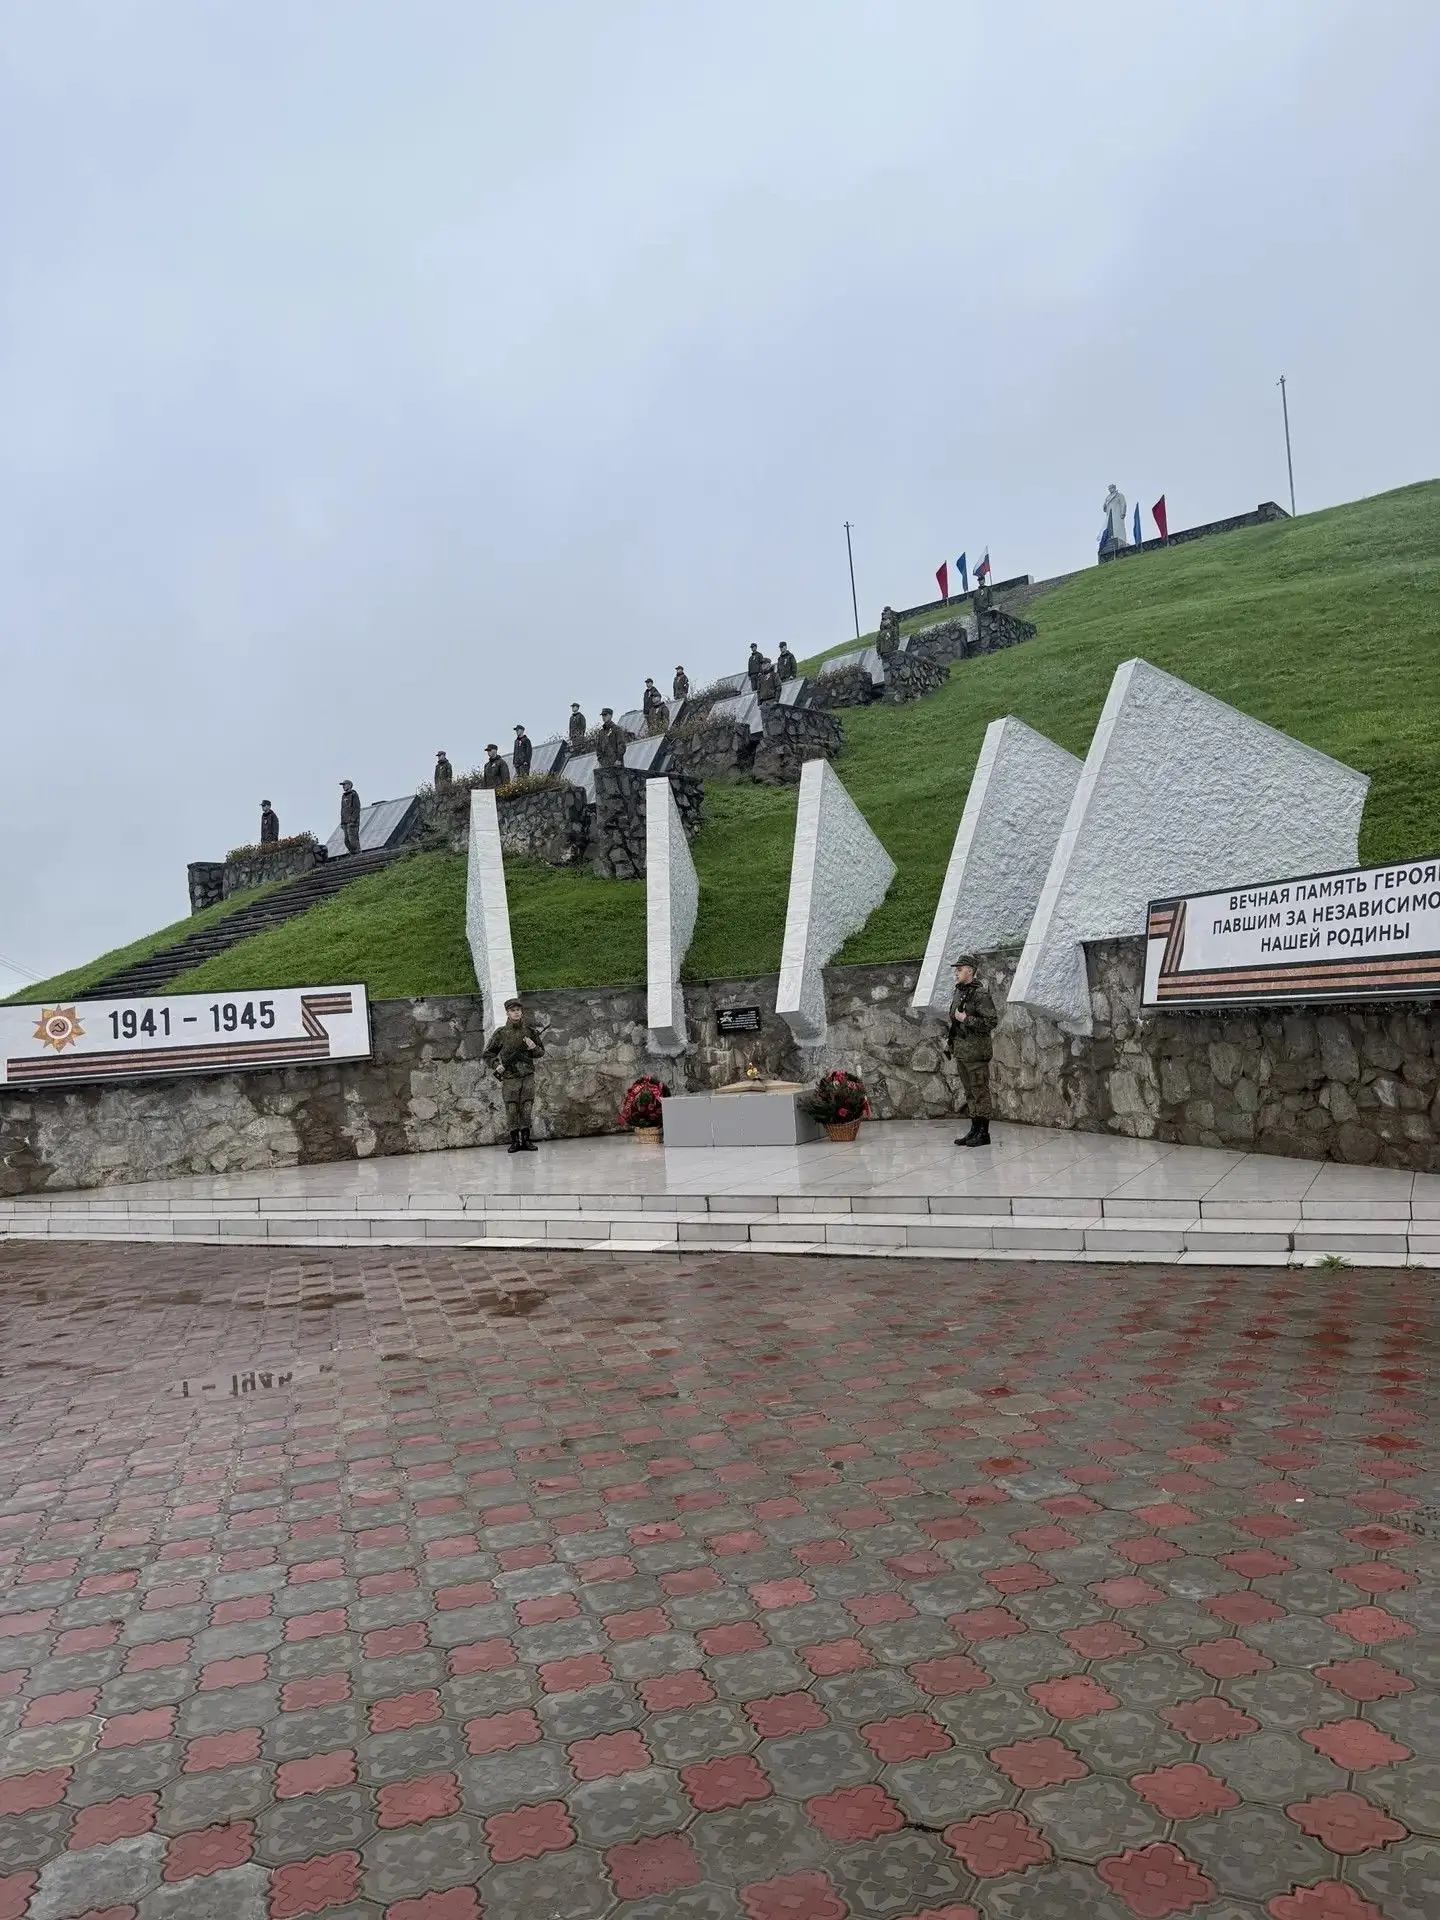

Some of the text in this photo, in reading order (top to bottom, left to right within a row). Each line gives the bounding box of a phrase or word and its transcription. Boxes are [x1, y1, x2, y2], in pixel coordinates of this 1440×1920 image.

[1229, 864, 1440, 911] ВЕЧНАЯ ПАМЯТЬ ГЕРОЯ
[1213, 912, 1281, 935] ПАВШИМ
[1286, 910, 1307, 926] ЗА
[1261, 922, 1410, 952] НАШЕЙ РОДИНЫ
[108, 1007, 171, 1039] 1941
[209, 1000, 276, 1032] 1945
